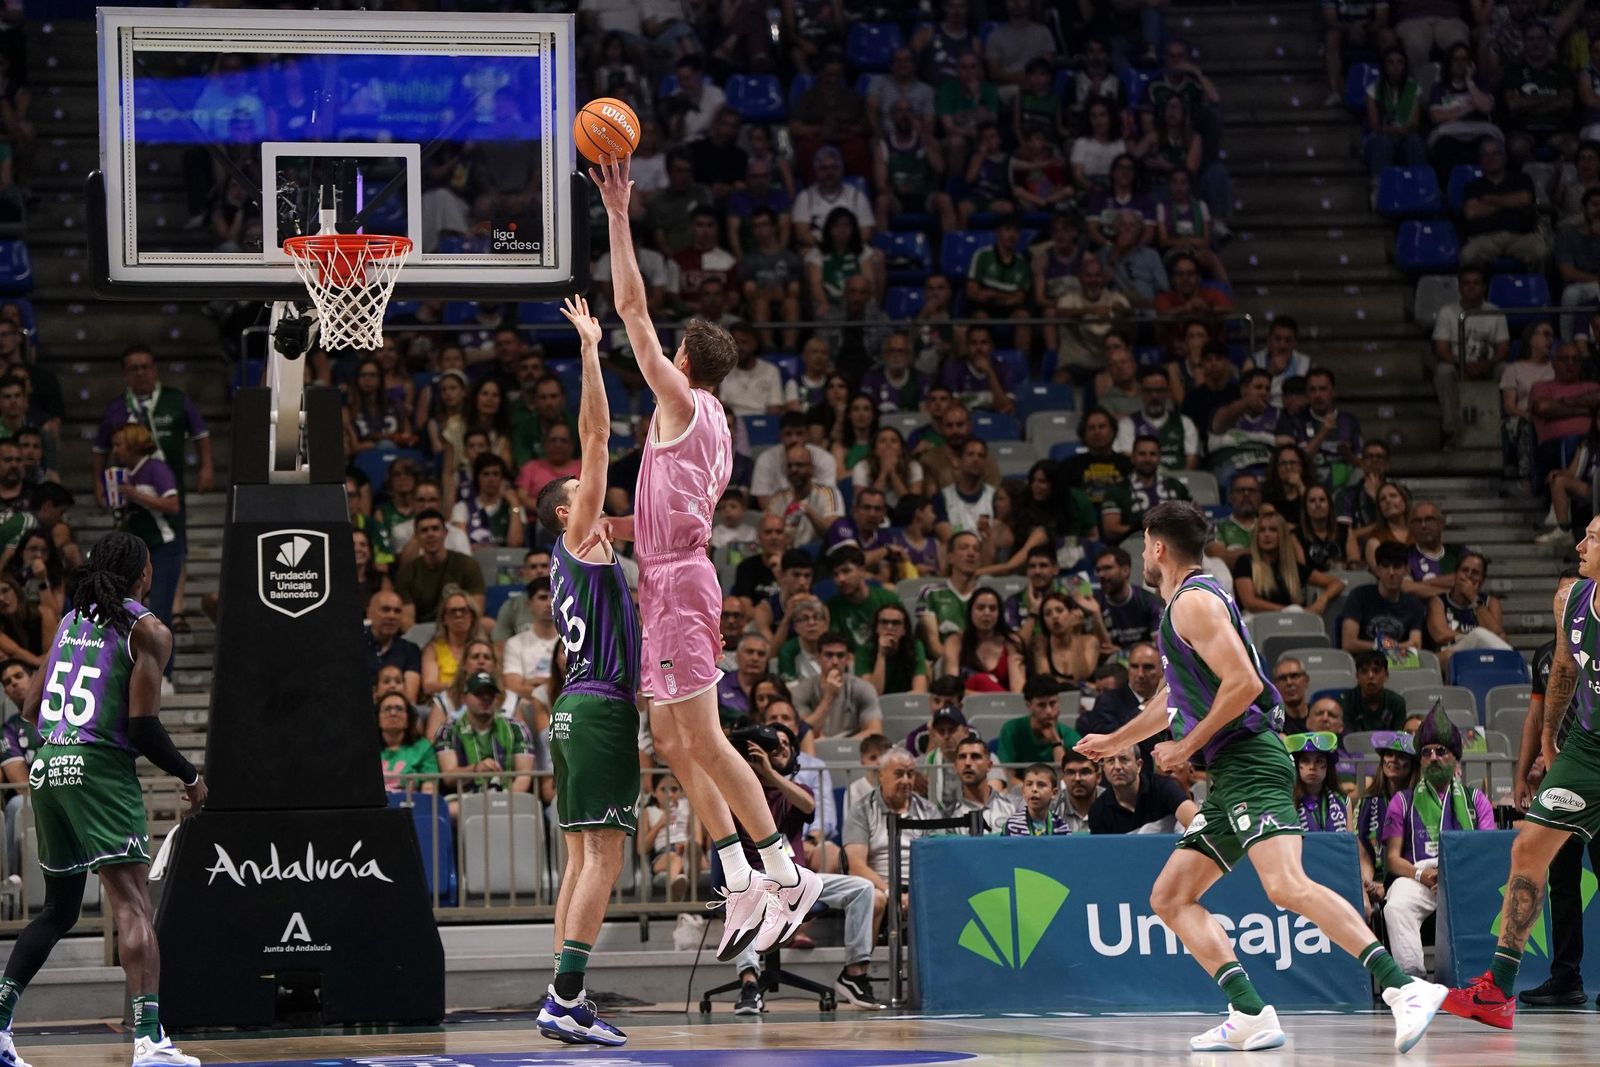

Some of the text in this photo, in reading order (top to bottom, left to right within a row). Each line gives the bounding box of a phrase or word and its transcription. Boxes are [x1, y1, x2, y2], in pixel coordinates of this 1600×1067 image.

[602, 105, 636, 140] Wilson
[493, 228, 515, 240] liga
[493, 239, 540, 250] endesa
[269, 570, 318, 580] Fundación
[277, 581, 312, 592] Unicaja
[270, 591, 319, 599] Baloncesto
[41, 661, 101, 727] 55
[49, 755, 85, 767] COSTA
[48, 766, 84, 778] DEL SOL
[49, 776, 83, 787] MÁLAGA
[205, 840, 395, 887] Andalucía
[1086, 902, 1332, 971] Uncaja
[295, 943, 332, 952] Andalucía
